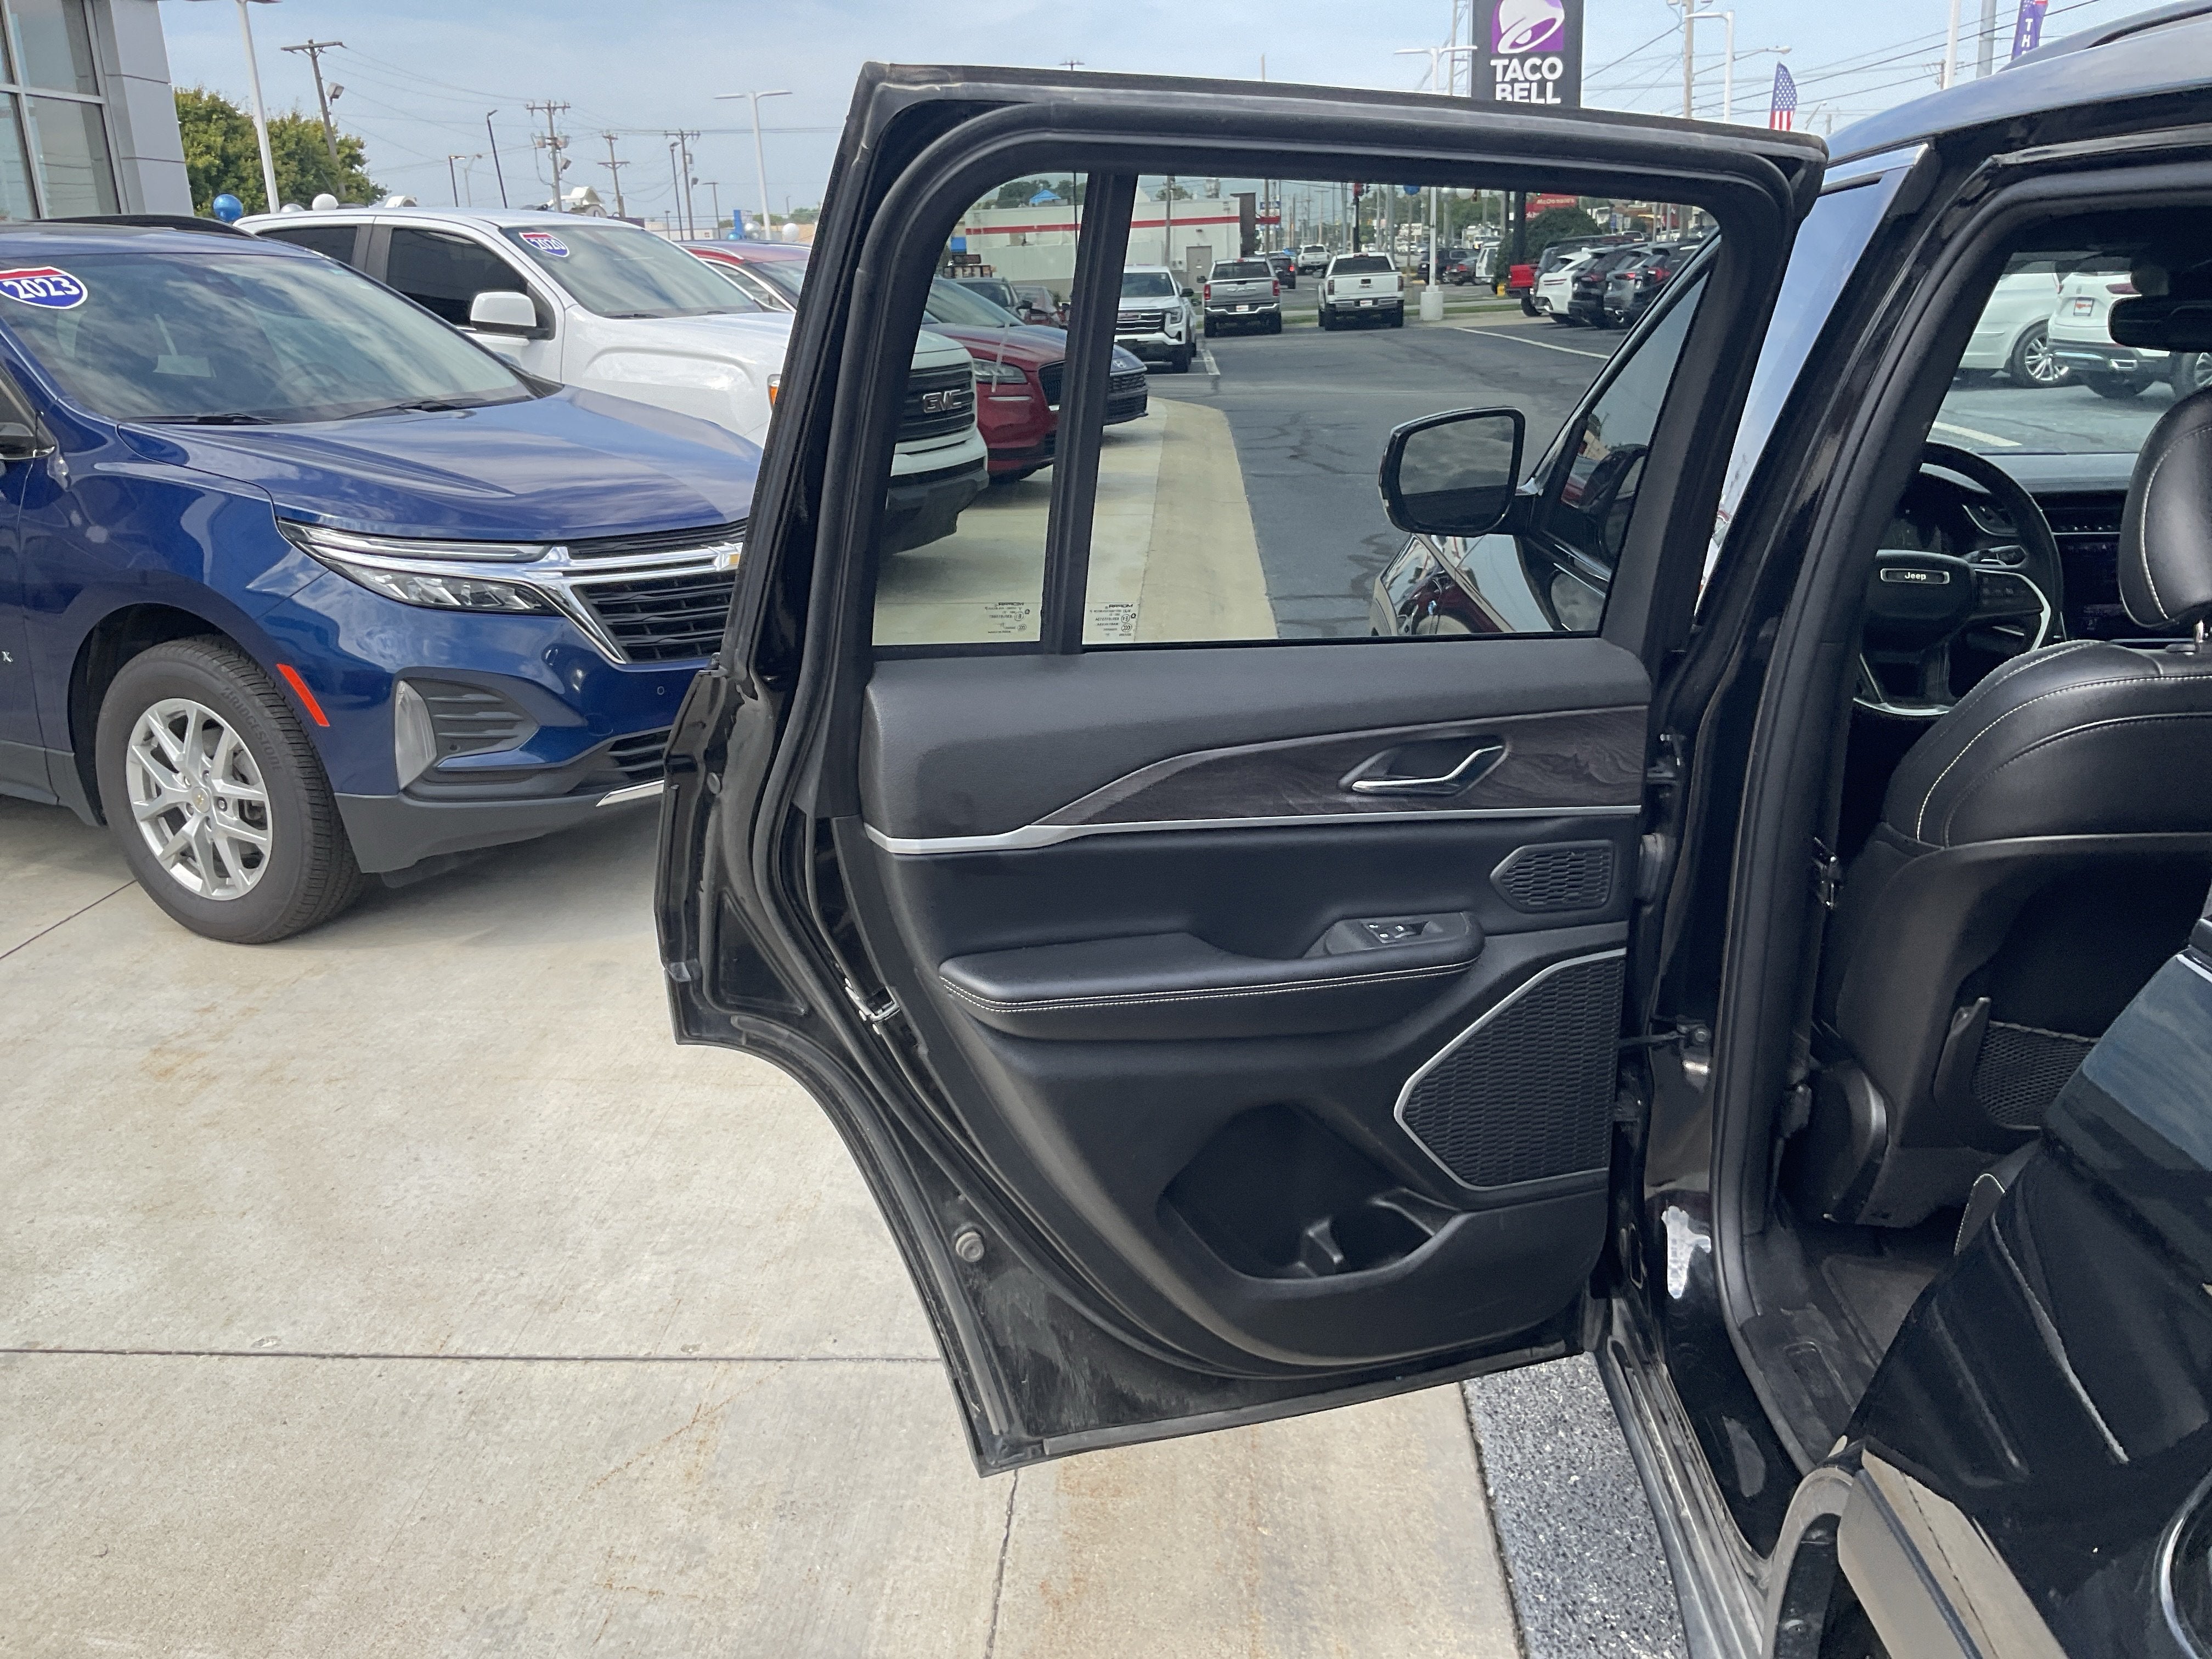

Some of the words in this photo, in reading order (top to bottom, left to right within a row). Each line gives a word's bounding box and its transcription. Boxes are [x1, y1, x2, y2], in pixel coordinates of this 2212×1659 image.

[1490, 57, 1564, 82] TACO
[1496, 82, 1561, 104] BELL
[529, 239, 566, 250] 2020
[2, 277, 80, 299] 2023
[923, 389, 962, 413] GMC
[1904, 572, 1927, 581] Jeep
[220, 687, 282, 769] BRIDGESTONE
